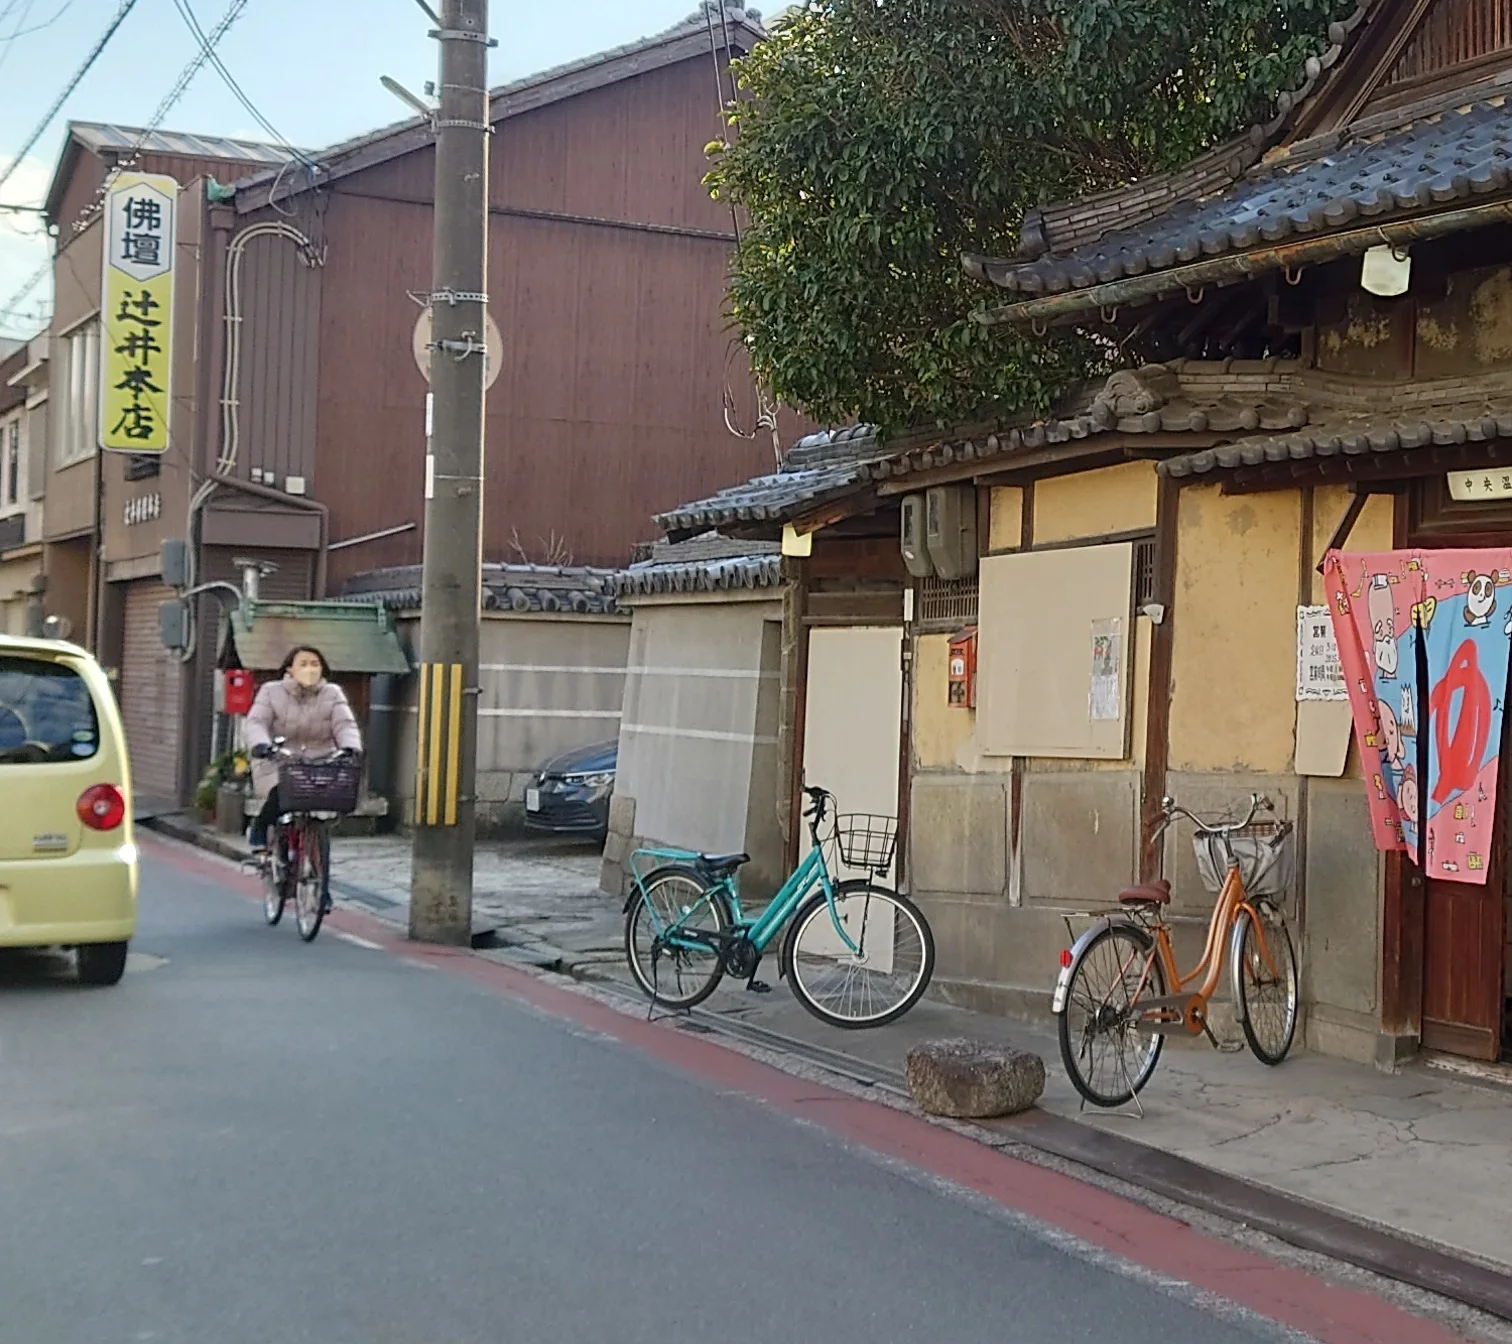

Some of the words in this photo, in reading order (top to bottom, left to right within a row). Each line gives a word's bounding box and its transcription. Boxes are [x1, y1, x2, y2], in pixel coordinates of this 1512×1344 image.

[120, 196, 162, 266] 佛壇
[111, 290, 165, 440] 辻井本店
